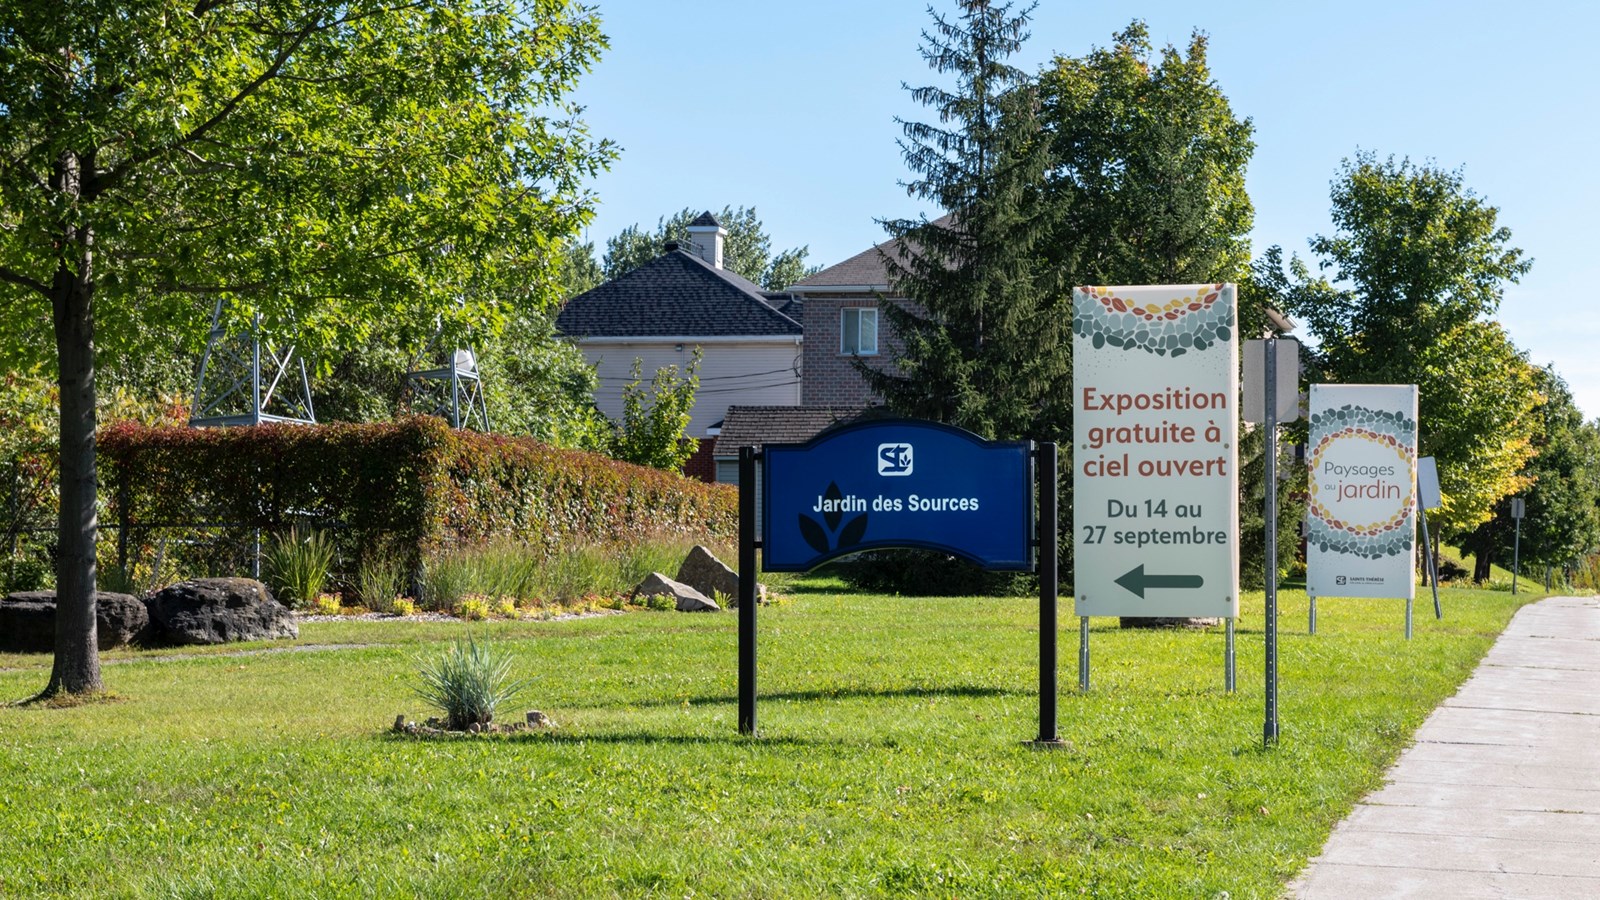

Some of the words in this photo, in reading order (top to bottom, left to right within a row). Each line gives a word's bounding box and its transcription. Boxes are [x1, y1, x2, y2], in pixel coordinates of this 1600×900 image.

[1083, 387, 1227, 415] Exposition
[1088, 420, 1196, 449] gratuite
[1204, 420, 1221, 443] à
[1083, 453, 1129, 477] ciel
[1137, 456, 1227, 477] ouvert
[1324, 461, 1395, 478] Paysages
[1336, 479, 1401, 502] jardin
[813, 494, 867, 512] Jardin
[872, 494, 903, 512] des
[907, 494, 979, 512] Sources
[1107, 499, 1138, 519] Du
[1144, 499, 1168, 519] 14
[1174, 505, 1202, 519] au
[1082, 525, 1107, 545] 27
[1113, 525, 1228, 548] septembre
